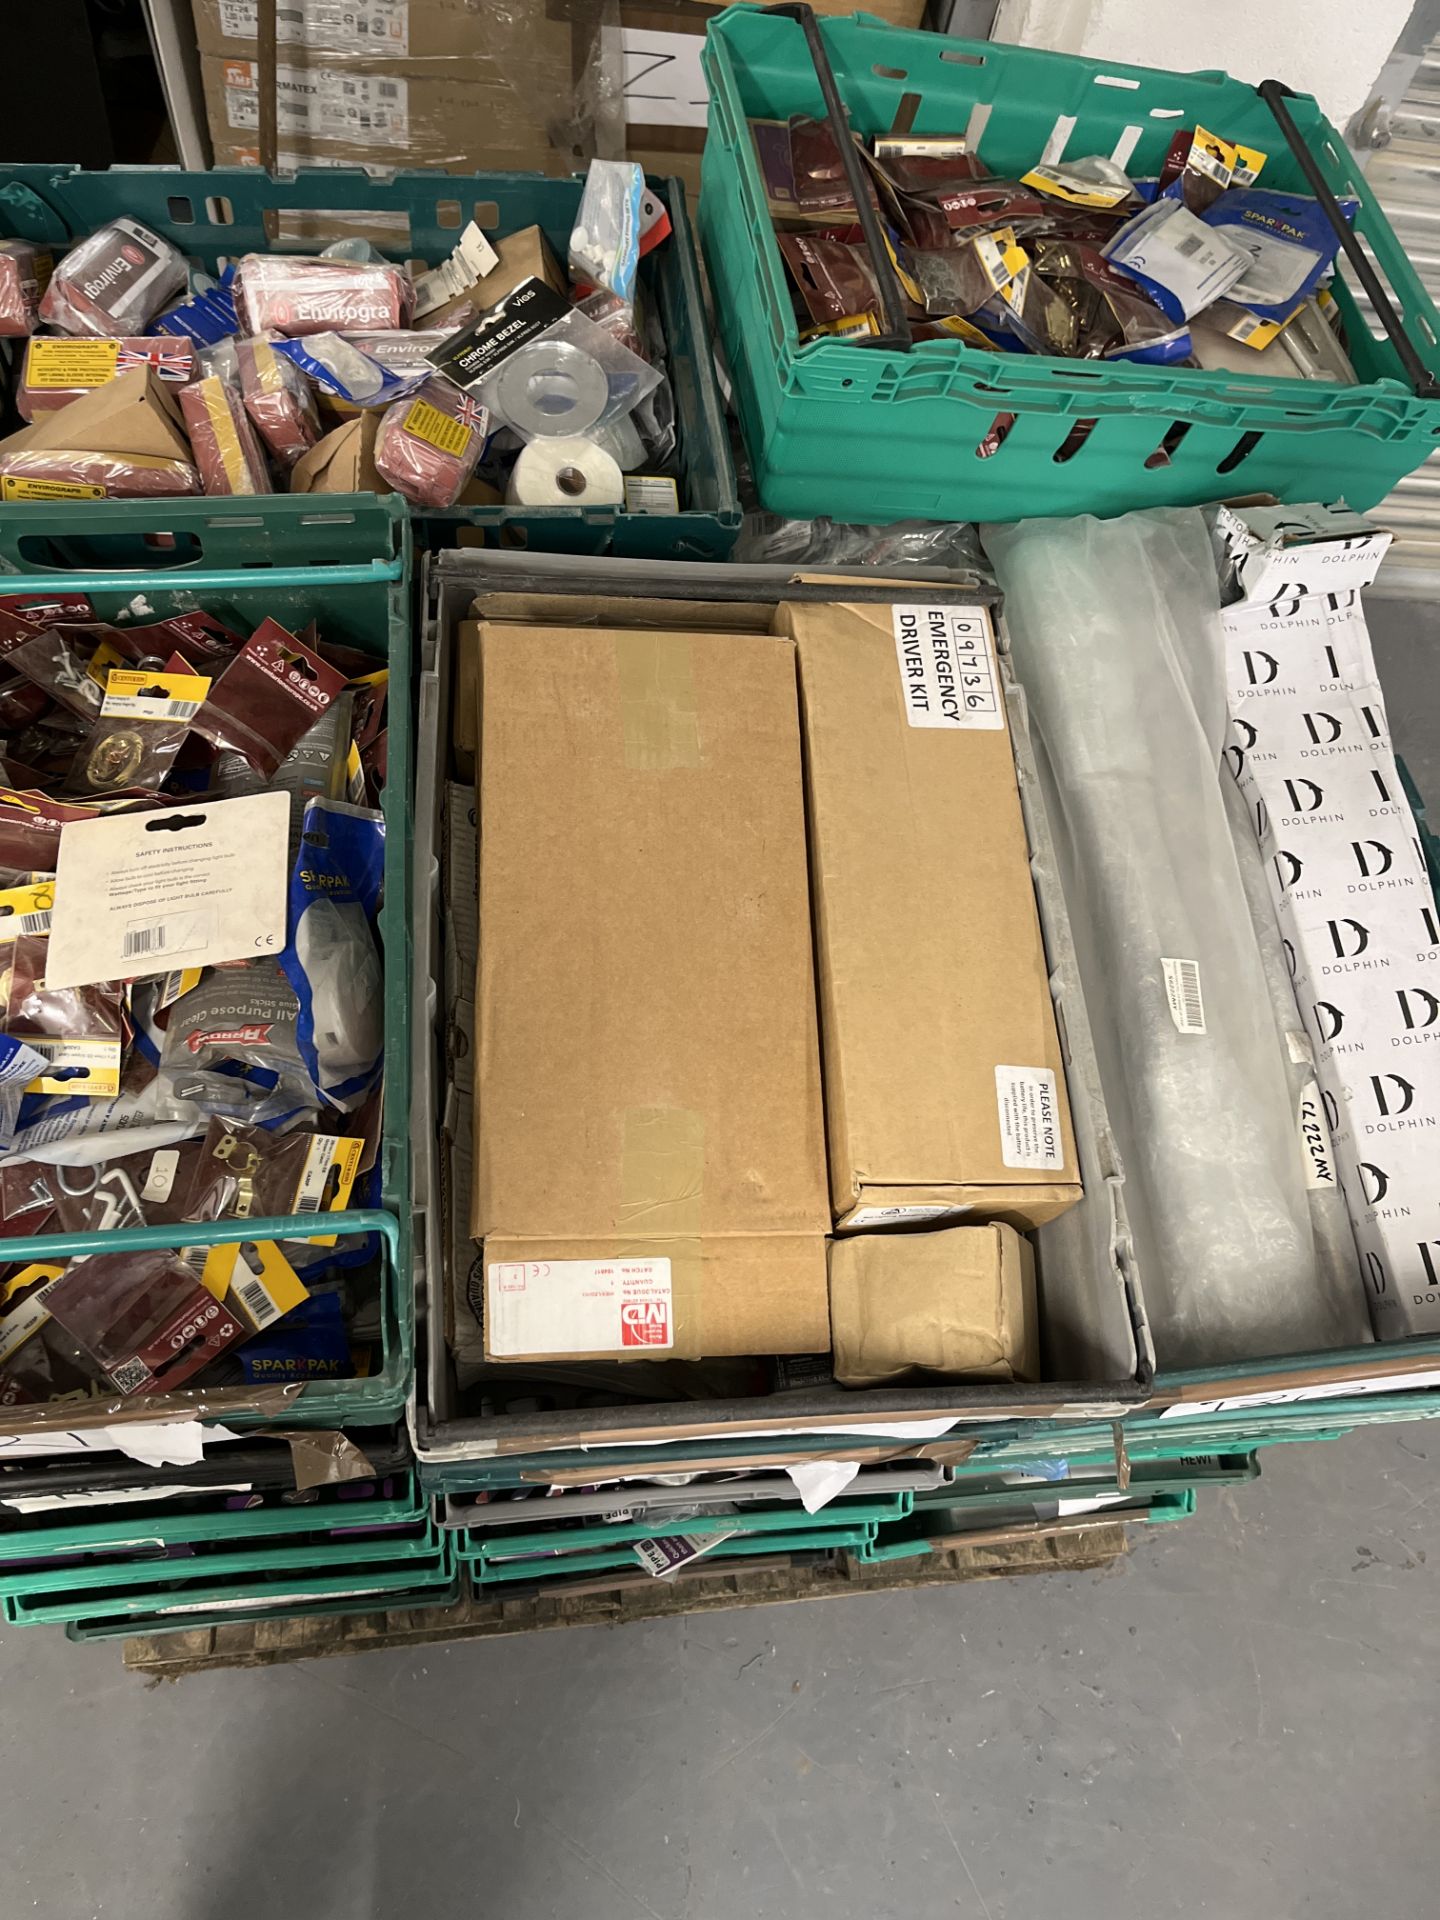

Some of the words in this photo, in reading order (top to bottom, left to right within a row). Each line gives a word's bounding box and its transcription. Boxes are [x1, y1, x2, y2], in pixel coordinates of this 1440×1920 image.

[1243, 210, 1306, 240] SPARKPAK
[458, 337, 499, 368] CHROME
[495, 318, 528, 341] BEZEL
[1321, 551, 1380, 564] DOLPHIN
[1260, 618, 1320, 631] DOLPHIN
[899, 614, 924, 678] DRIVER
[928, 611, 960, 721] EMERGENCY
[909, 684, 930, 712] KIT
[1237, 687, 1297, 698] DOLPHIN
[1300, 744, 1363, 758] DOLPHIN
[1281, 813, 1344, 827] DOLPHIN
[135, 848, 162, 858] SAFETY
[162, 841, 213, 853] INSTRUCTIONS
[1347, 877, 1415, 893] DOLPHIN
[109, 903, 132, 911] ALWAYS
[133, 899, 157, 908] DISPOSE
[166, 894, 184, 902] LIGHT
[184, 891, 200, 899] BULB
[200, 887, 233, 897] CAREFULLY
[1321, 958, 1391, 975] DOLPHIN
[210, 1005, 272, 1018] Purpose
[250, 998, 277, 1008] Sticks
[180, 1009, 208, 1028] Clear
[276, 1009, 298, 1021] All
[1039, 1083, 1052, 1123] PLEASE
[1365, 1116, 1437, 1134] DOLPHIN
[1043, 1126, 1056, 1158] NOTE
[251, 1359, 339, 1371] SPARKPAK
[605, 1508, 629, 1520] PIPE
[646, 1551, 665, 1568] PIPE
